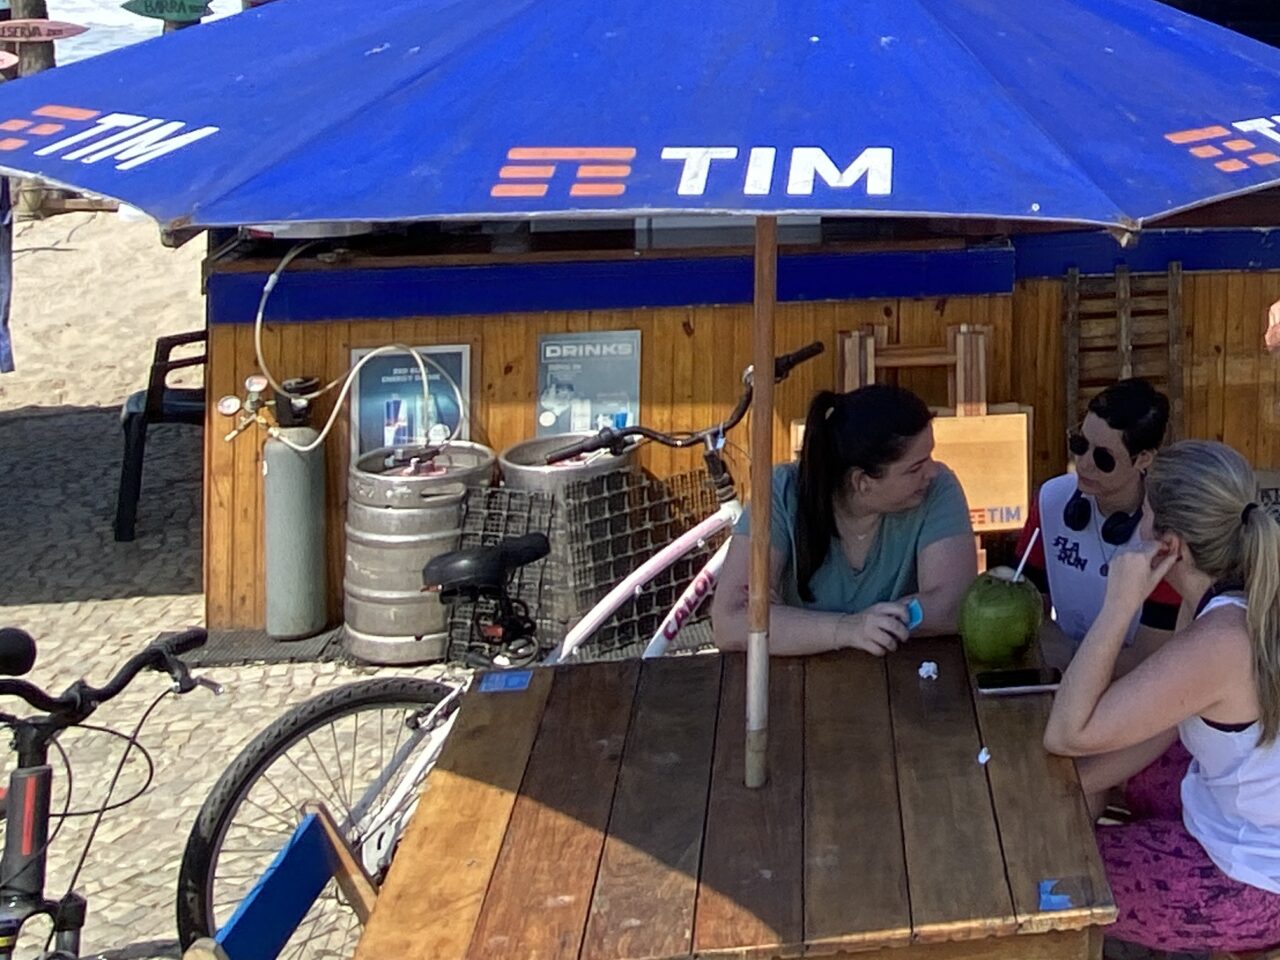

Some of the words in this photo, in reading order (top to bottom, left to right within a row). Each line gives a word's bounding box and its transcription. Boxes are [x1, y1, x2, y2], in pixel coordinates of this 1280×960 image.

[33, 112, 221, 171] TIM
[660, 146, 895, 196] TIM
[544, 343, 633, 358] DRINKS
[986, 506, 1021, 523] TIM
[1052, 535, 1081, 554] FLA
[1057, 550, 1089, 572] RUN
